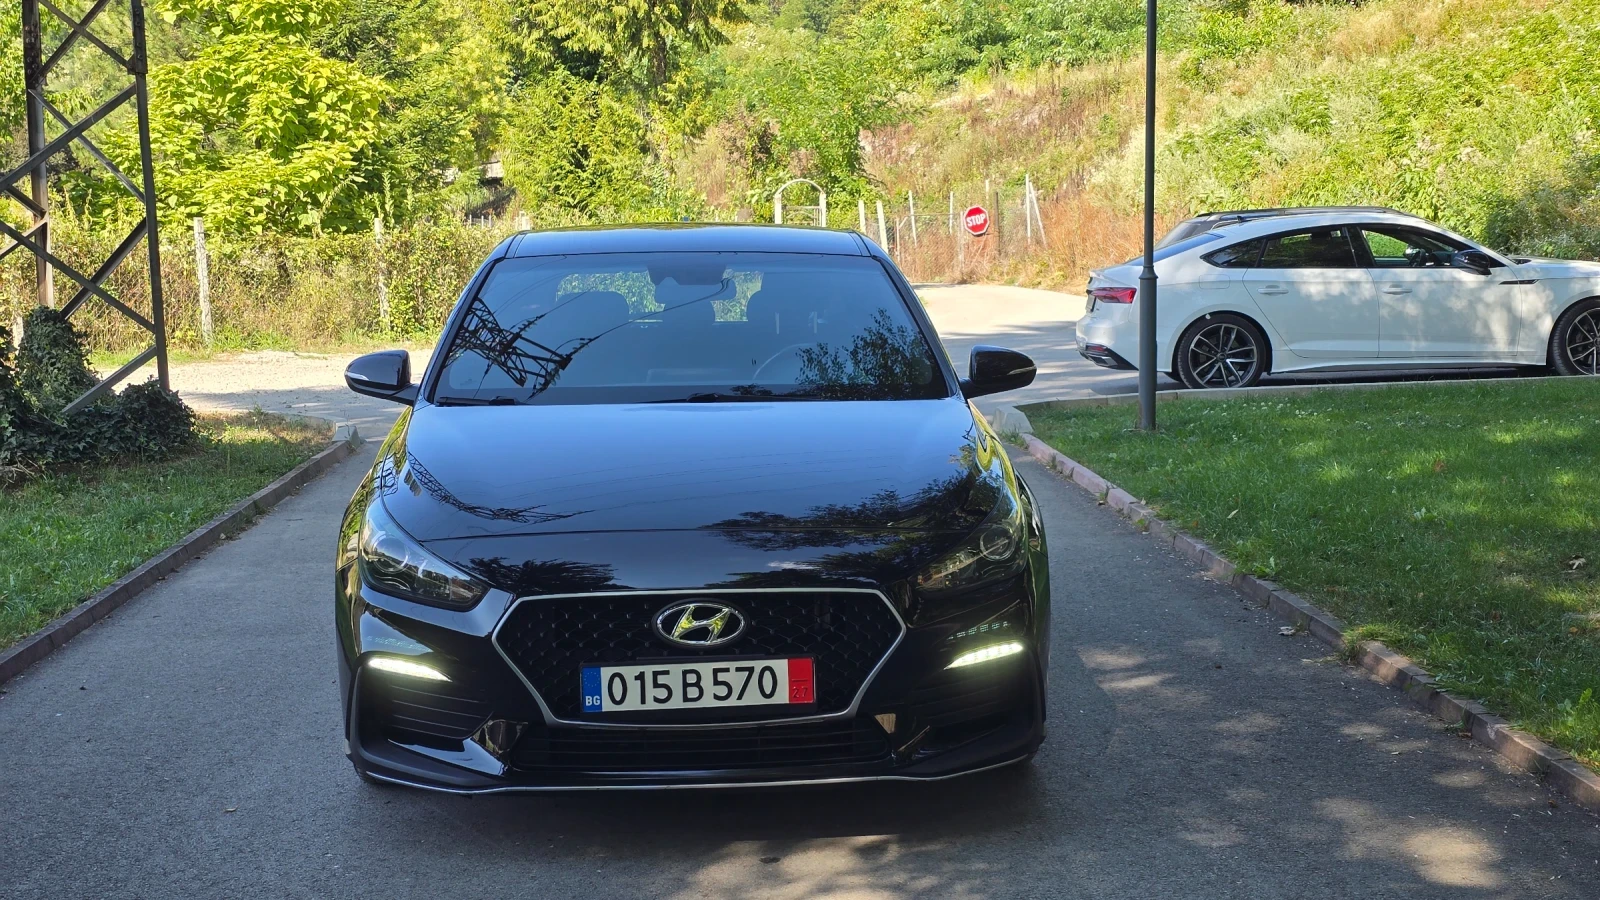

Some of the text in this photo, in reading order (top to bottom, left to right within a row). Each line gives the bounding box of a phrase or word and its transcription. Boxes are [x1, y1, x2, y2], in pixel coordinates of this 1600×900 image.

[967, 213, 986, 227] STOP
[792, 686, 808, 698] 27
[585, 695, 601, 706] BG
